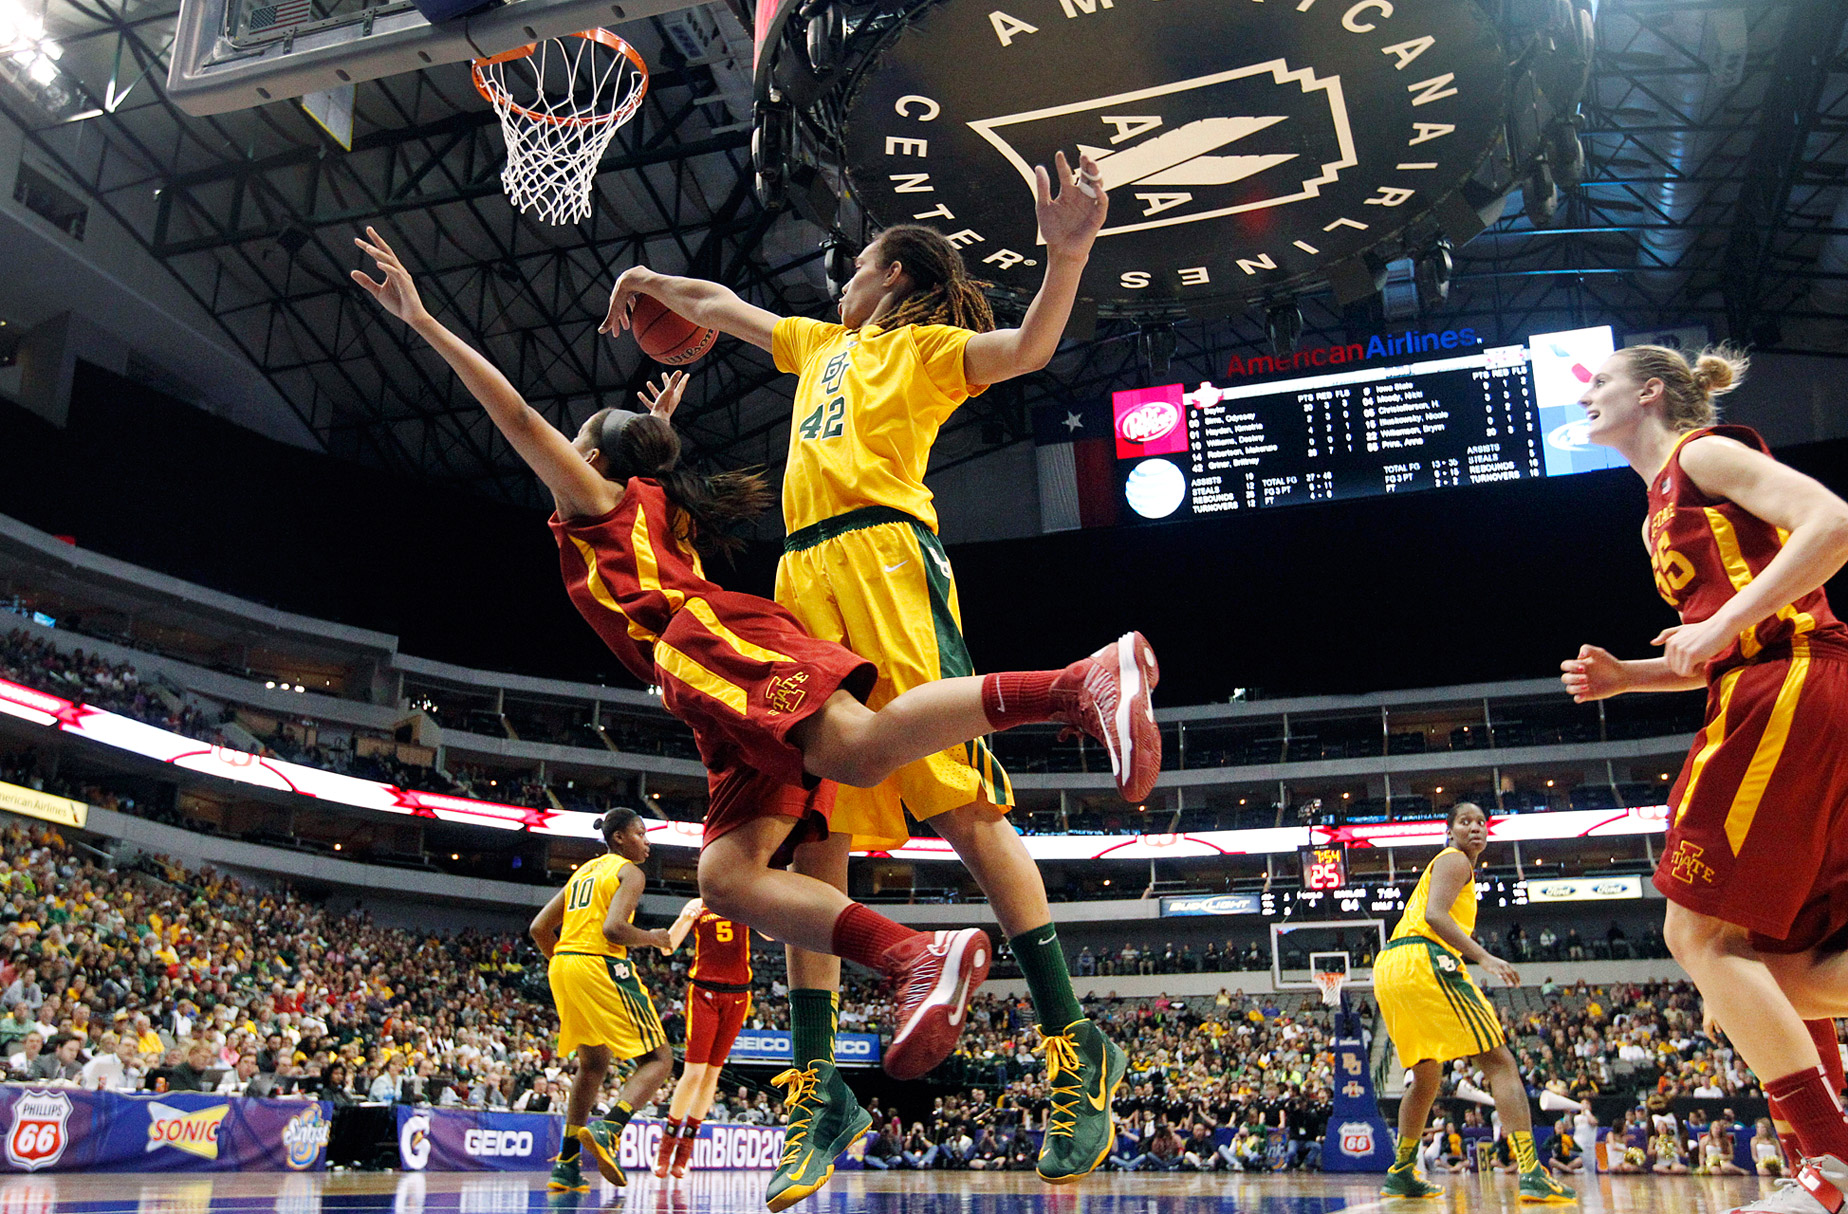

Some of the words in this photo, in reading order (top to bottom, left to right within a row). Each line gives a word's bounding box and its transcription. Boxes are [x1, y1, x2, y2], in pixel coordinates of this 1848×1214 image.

[666, 328, 714, 364] Wilson
[799, 396, 845, 440] 42
[1383, 464, 1408, 473] TOTAL
[1469, 461, 1515, 474] REBOUNDS
[1191, 476, 1222, 487] ASSISTS
[1262, 477, 1285, 487] TOTAL
[1470, 470, 1520, 483] TURNOVERS
[1192, 486, 1220, 496] STEALS
[1193, 493, 1234, 504] REBOUNDS
[1192, 501, 1238, 513] TURNOVERS
[1313, 850, 1341, 864] 7:54
[1311, 863, 1341, 889] 25
[568, 877, 596, 912] 10
[1545, 885, 1571, 897] Ford
[1597, 882, 1622, 895] Ford
[1211, 899, 1251, 909] LIGHT
[716, 920, 734, 943] 5
[735, 1035, 791, 1052] GEICO
[22, 1103, 64, 1117] PHILLIPS
[153, 1119, 221, 1143] SONIC
[17, 1123, 57, 1154] 66
[464, 1128, 534, 1157] GEICO
[1346, 1136, 1368, 1149] 66
